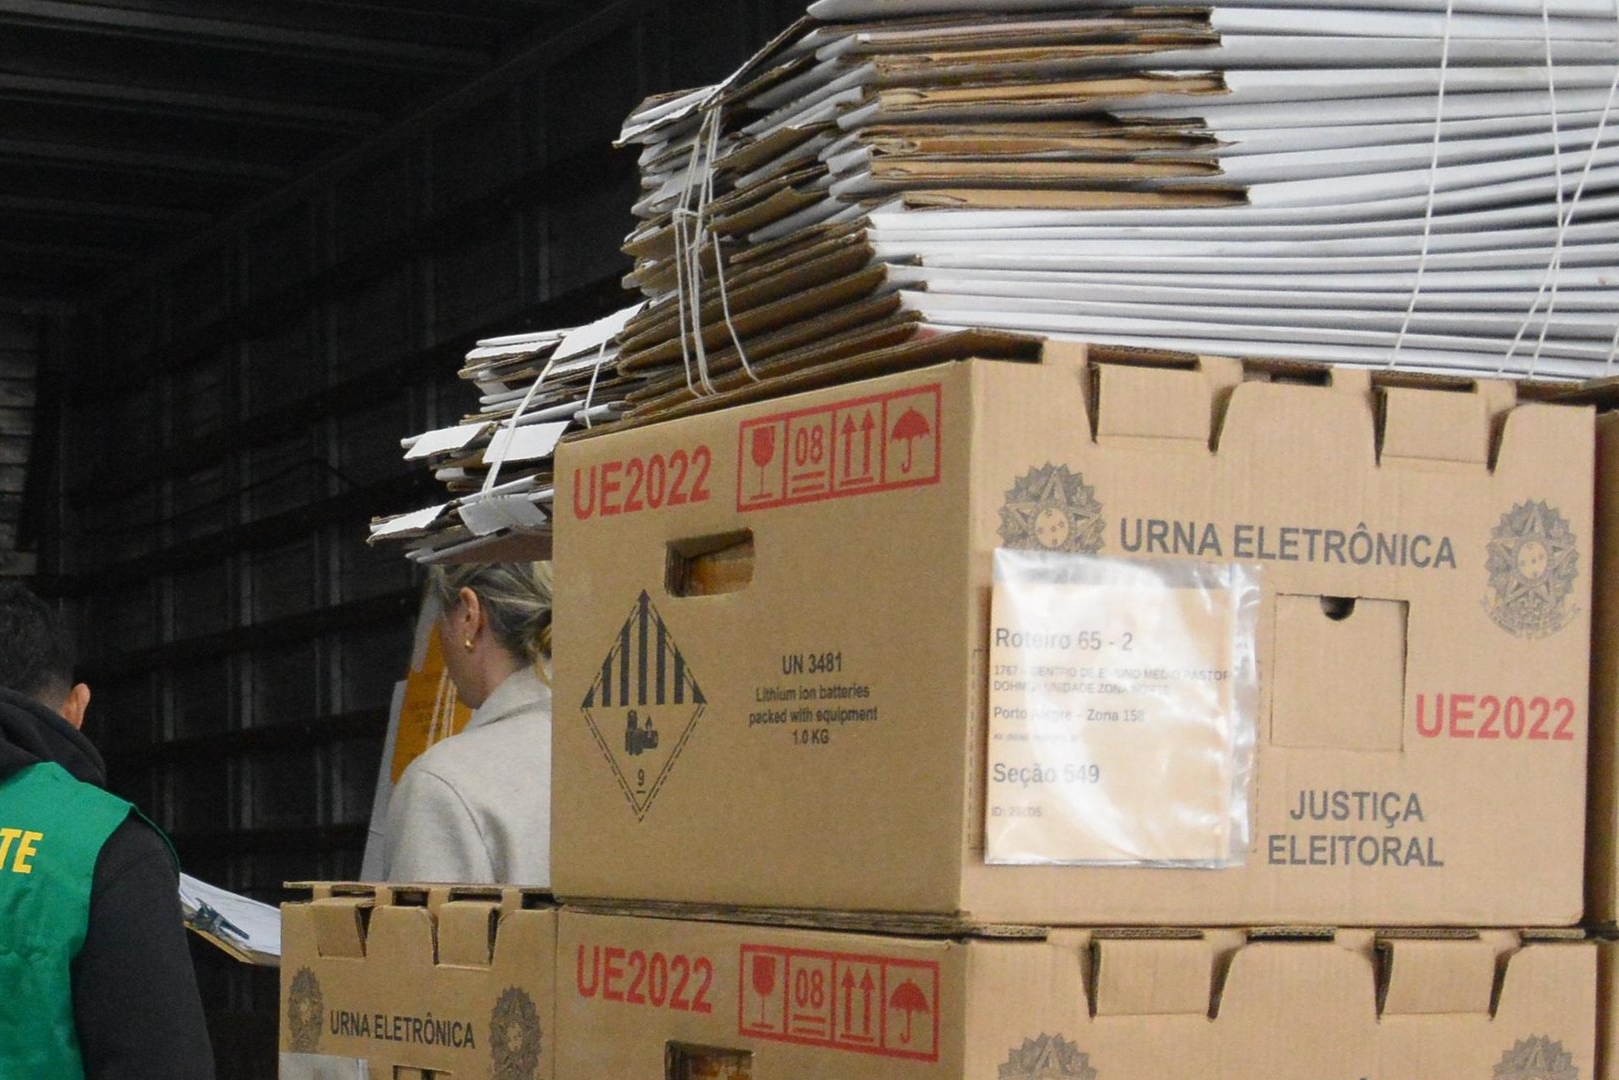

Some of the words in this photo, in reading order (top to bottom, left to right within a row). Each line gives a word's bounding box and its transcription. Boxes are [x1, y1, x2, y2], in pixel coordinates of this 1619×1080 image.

[572, 445, 712, 521] UE2022
[795, 425, 823, 465] 08
[1120, 518, 1222, 558] URNA
[1233, 522, 1457, 570] ELETRÔNICA
[995, 628, 1071, 648] Roteiro
[1078, 631, 1102, 650] 65
[1121, 632, 1133, 651] 2
[783, 655, 802, 675] UN
[809, 652, 842, 674] 3481
[756, 686, 796, 702] Lithium
[799, 686, 816, 700] ion
[819, 684, 869, 699] batteries
[749, 709, 786, 727] packed
[790, 707, 813, 723] with
[817, 706, 878, 725] equipment
[994, 707, 1027, 720] Porto
[1087, 709, 1119, 722] Zona
[1123, 710, 1145, 722] 158
[1416, 694, 1575, 741] UE2022
[792, 729, 809, 745] 1.0
[811, 728, 829, 745] KG
[637, 769, 645, 787] 9
[993, 764, 1056, 789] Seção
[1290, 791, 1424, 829] JUSTIÇA
[1268, 834, 1443, 867] ELEITORAL
[577, 944, 713, 1013] UE2022
[795, 968, 824, 1008] 08
[330, 1010, 370, 1038] URNA
[374, 1012, 475, 1050] ELETRÔNICA
